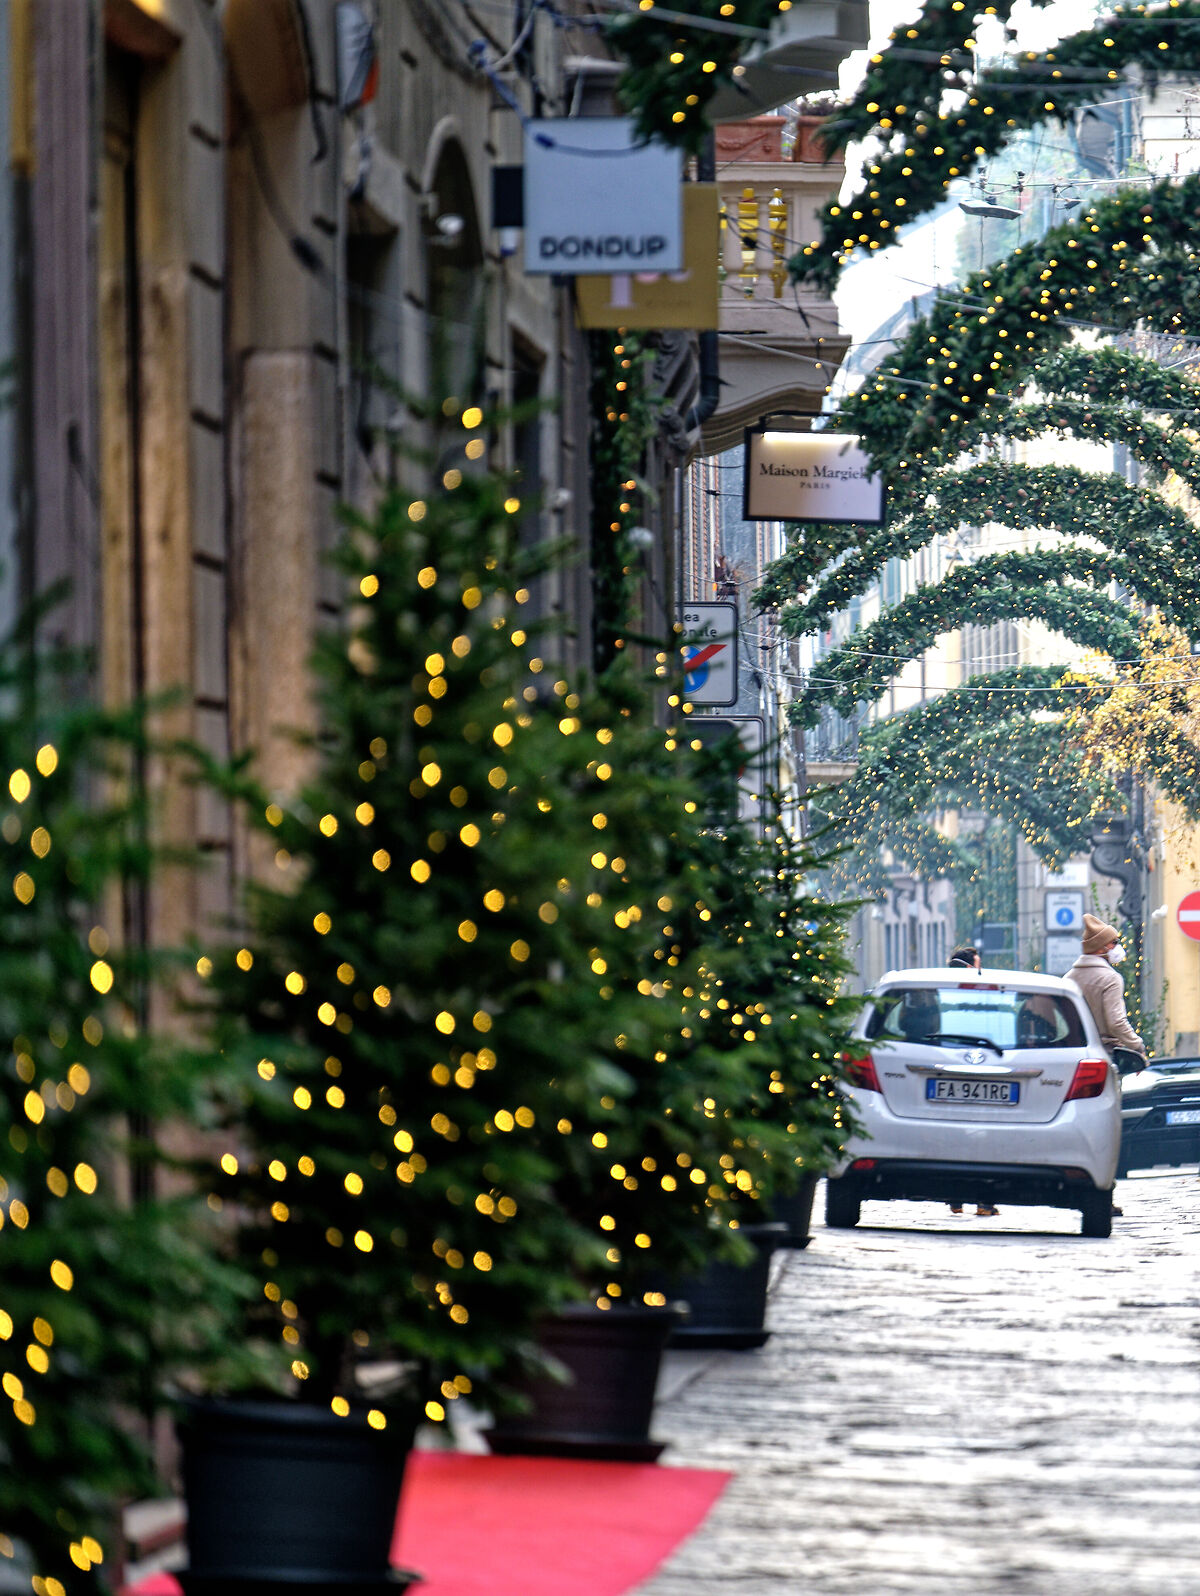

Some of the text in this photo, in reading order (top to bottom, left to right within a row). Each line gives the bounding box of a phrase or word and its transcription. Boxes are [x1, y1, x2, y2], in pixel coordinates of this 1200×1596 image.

[539, 236, 667, 259] DONDUP
[760, 463, 872, 481] Maison Margiel
[684, 614, 700, 622] ea
[937, 1082, 1009, 1100] FA 941RG
